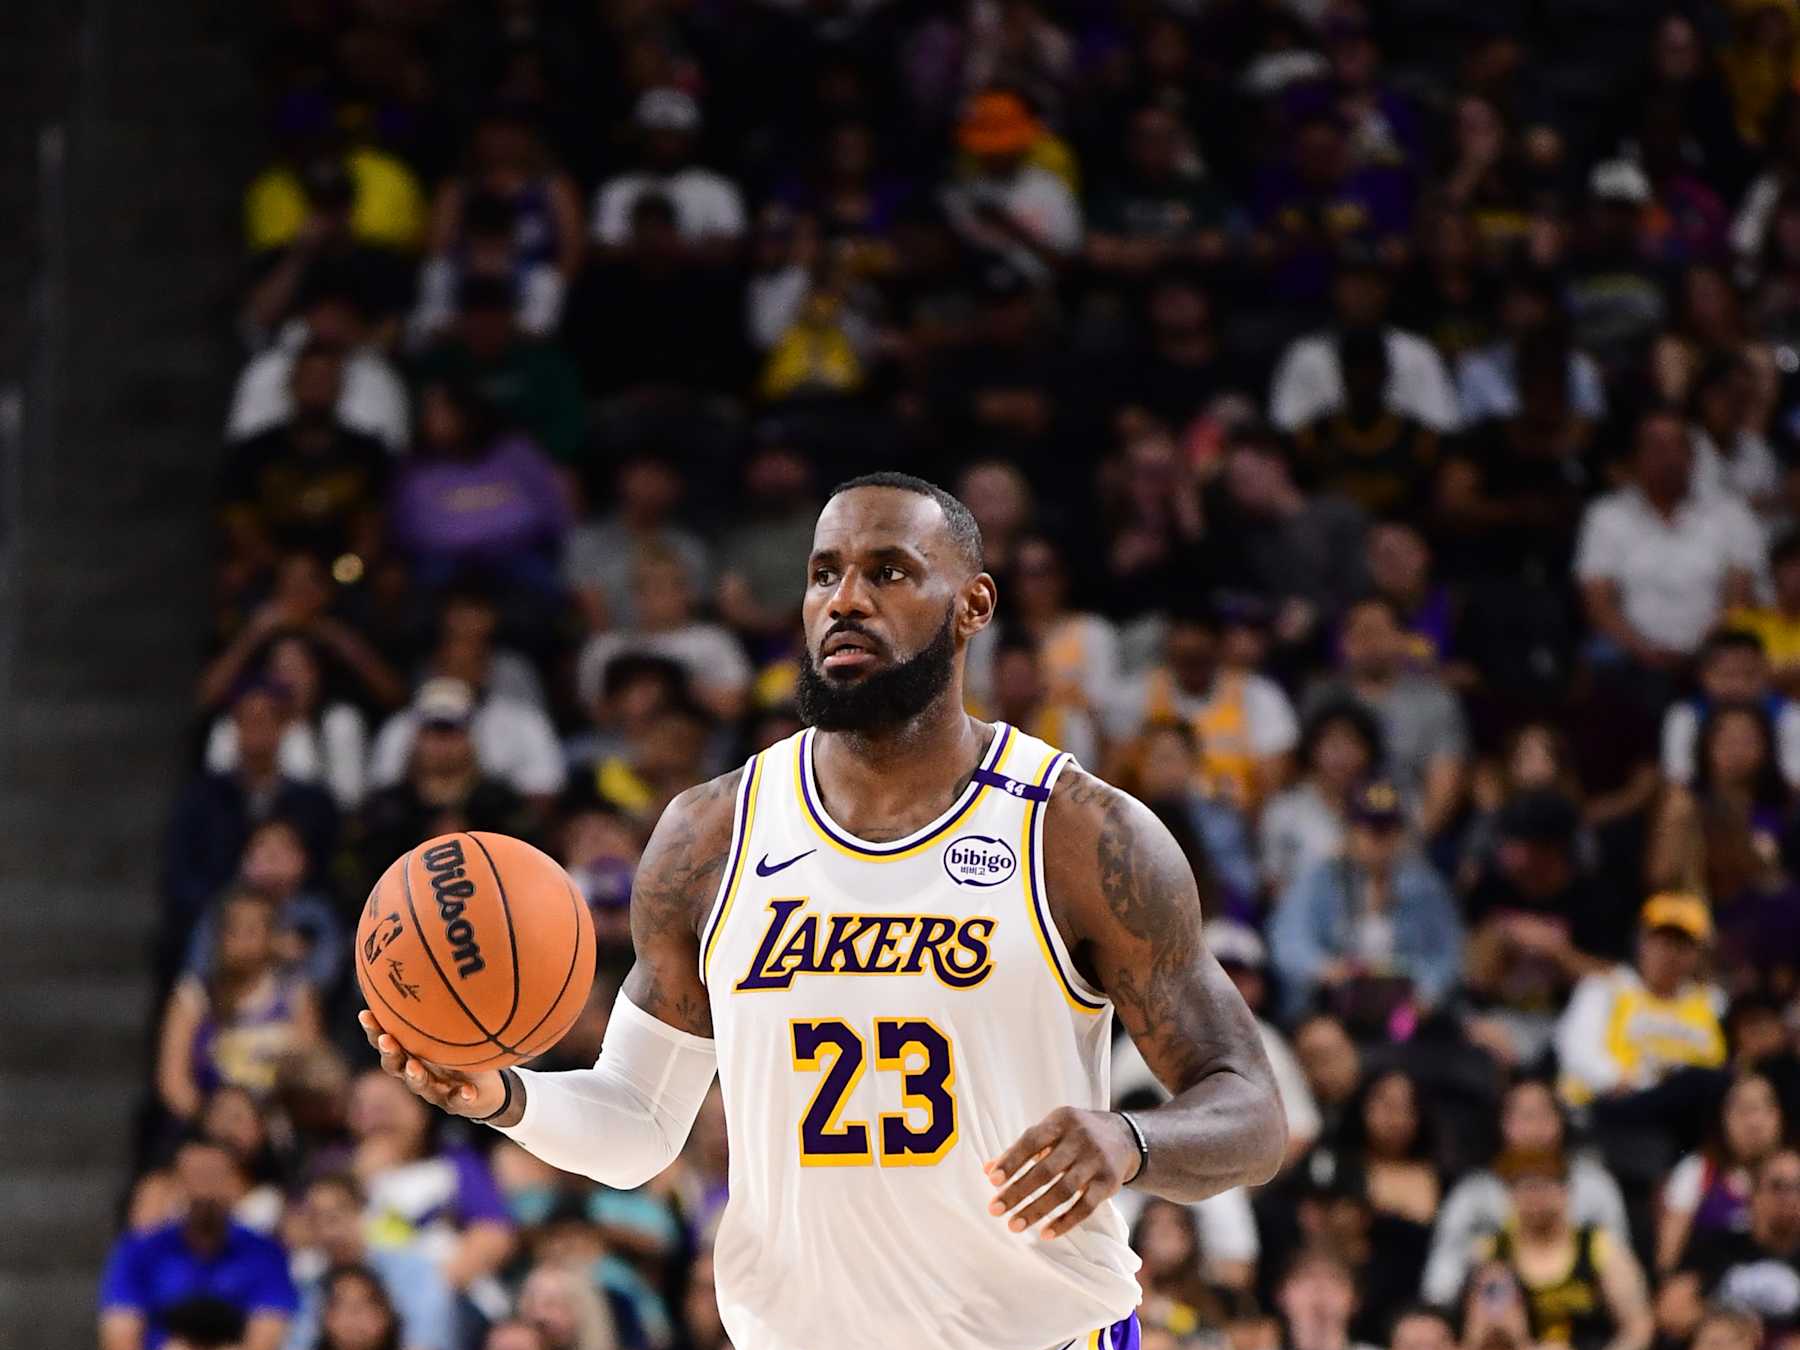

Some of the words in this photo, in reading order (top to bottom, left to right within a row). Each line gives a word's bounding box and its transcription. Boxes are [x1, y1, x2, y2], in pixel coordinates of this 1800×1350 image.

[1004, 780, 1026, 797] 44
[951, 848, 1012, 873] bibigo
[422, 839, 486, 980] Wilson
[731, 896, 999, 993] LAKERS
[789, 1016, 959, 1168] 23
